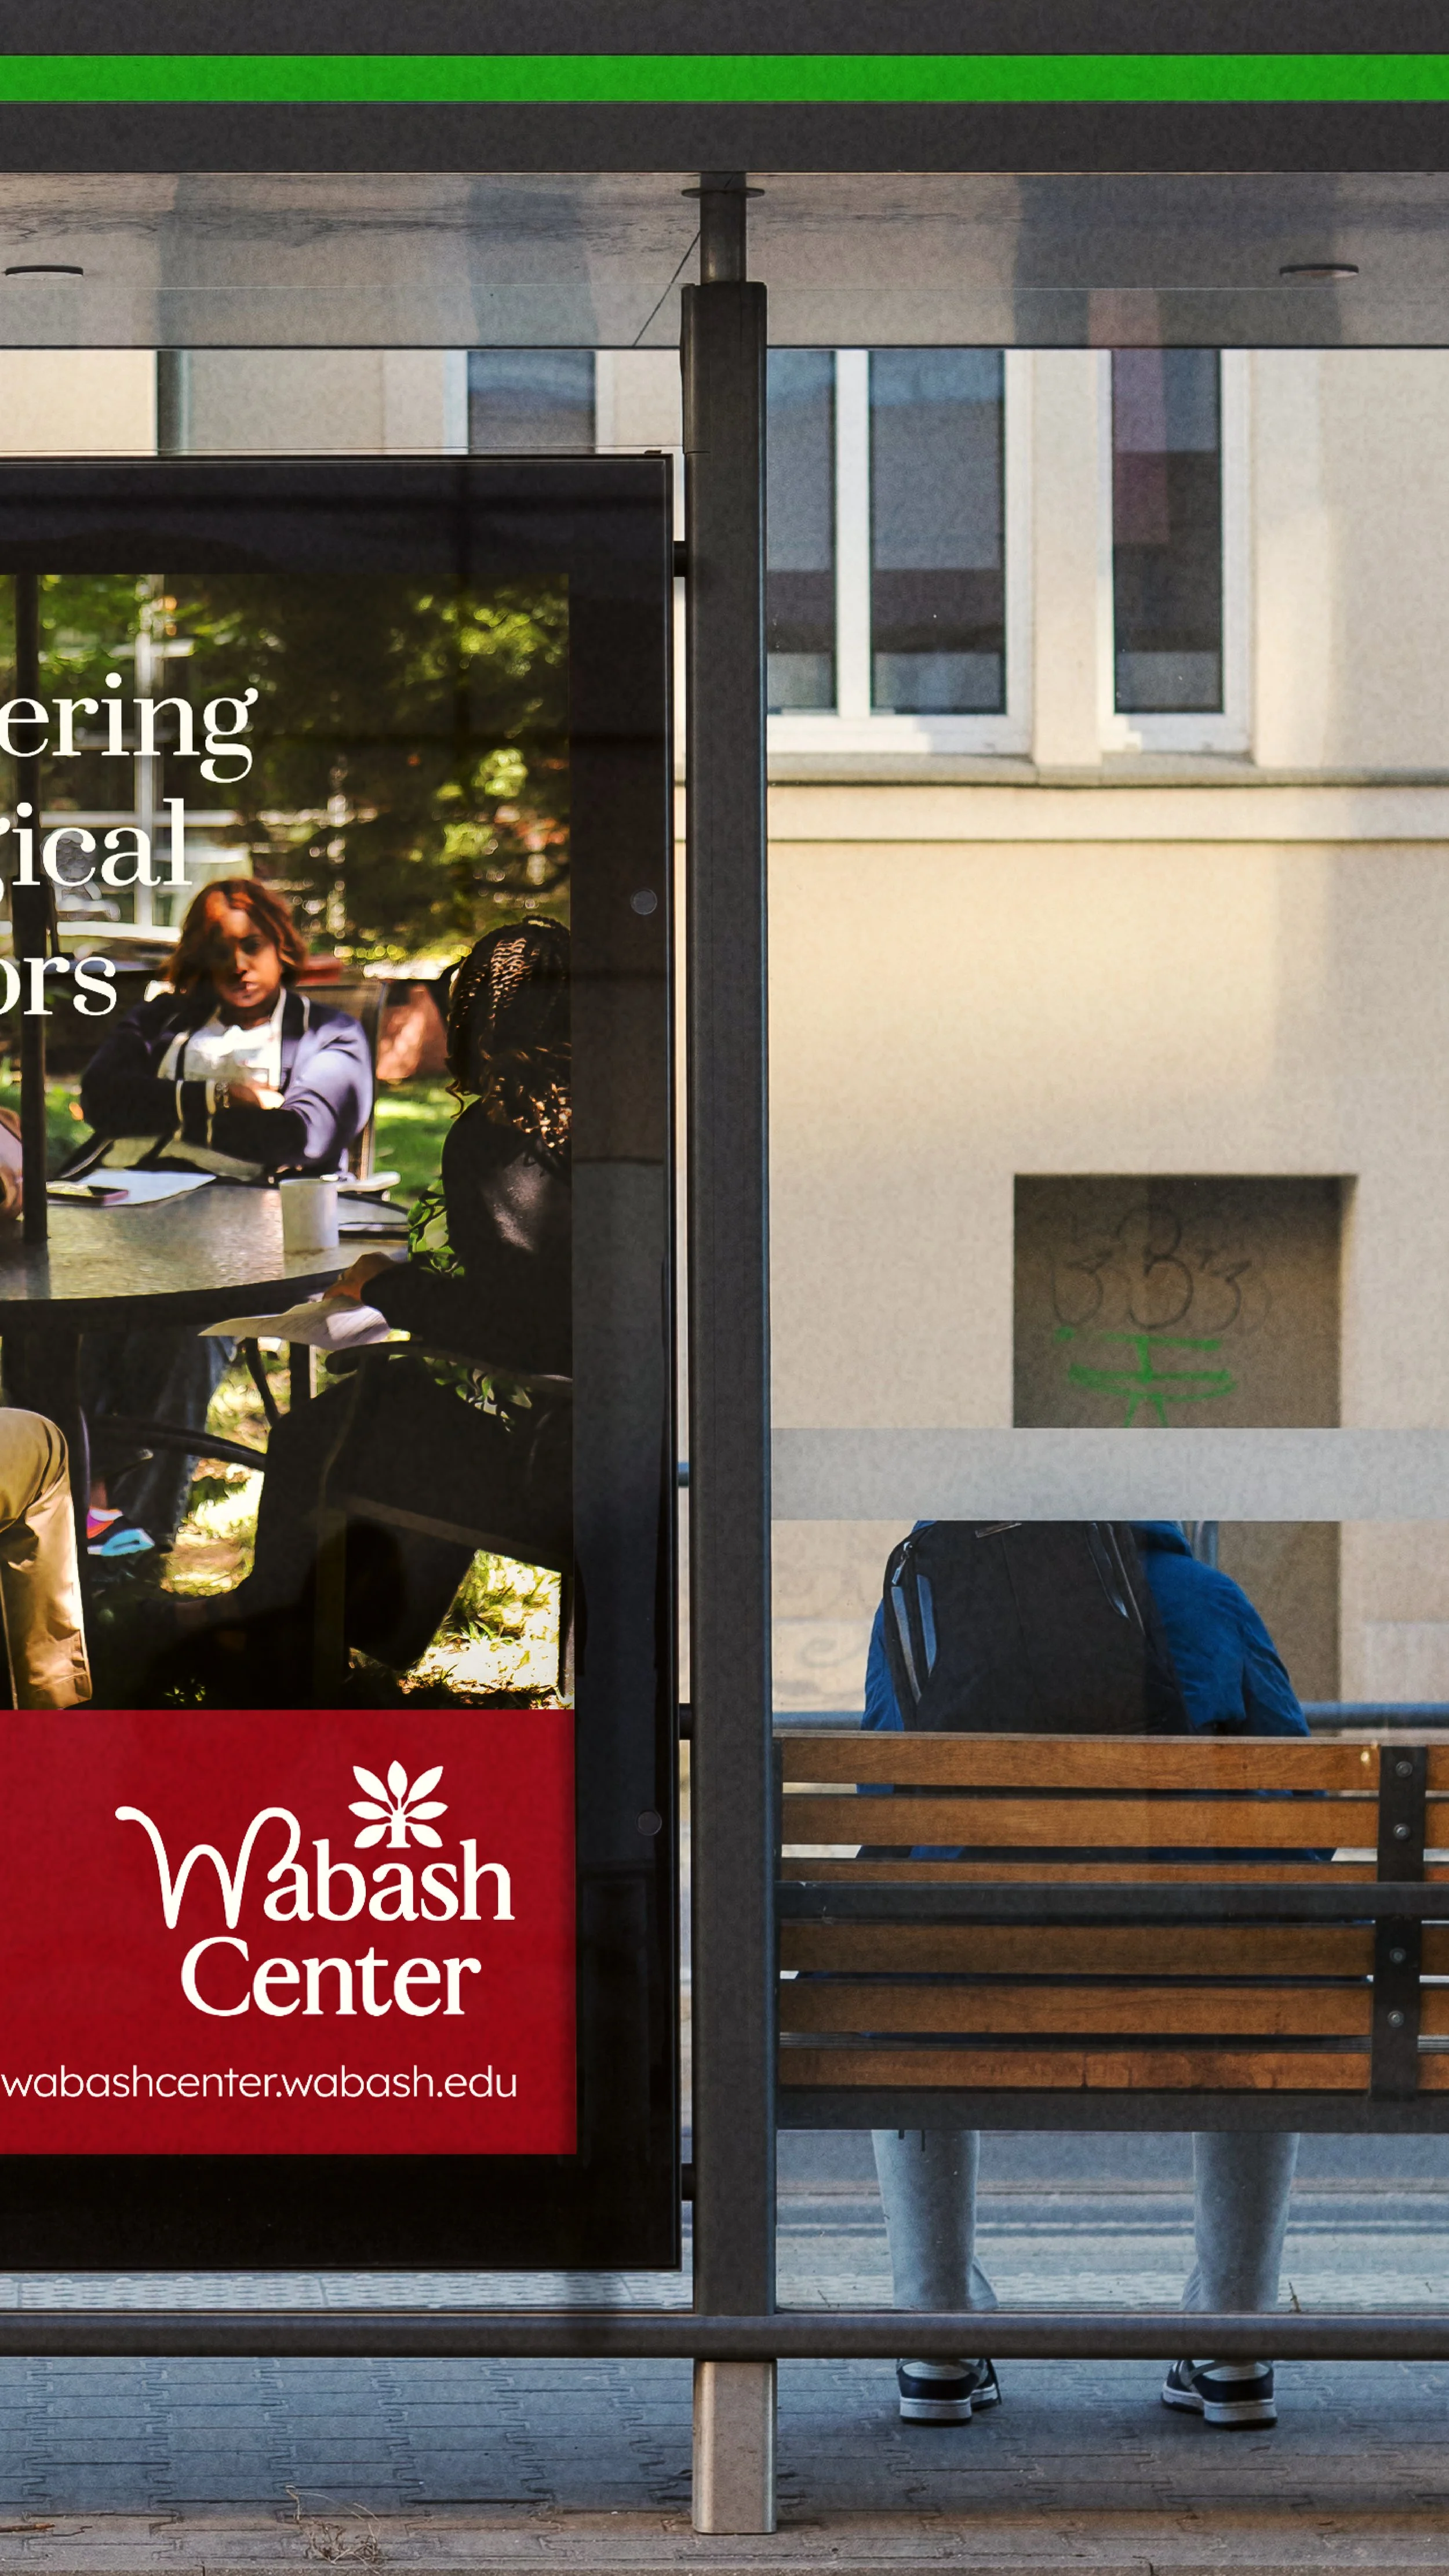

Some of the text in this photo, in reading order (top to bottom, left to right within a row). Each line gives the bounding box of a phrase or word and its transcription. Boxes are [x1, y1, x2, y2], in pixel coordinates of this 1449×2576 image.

[0, 672, 259, 783] ering
[0, 798, 193, 901] ical
[115, 1806, 515, 1929] Wabash
[181, 1936, 482, 2017] Center
[1, 2065, 517, 2098] wabashcenter.wabash.edu
